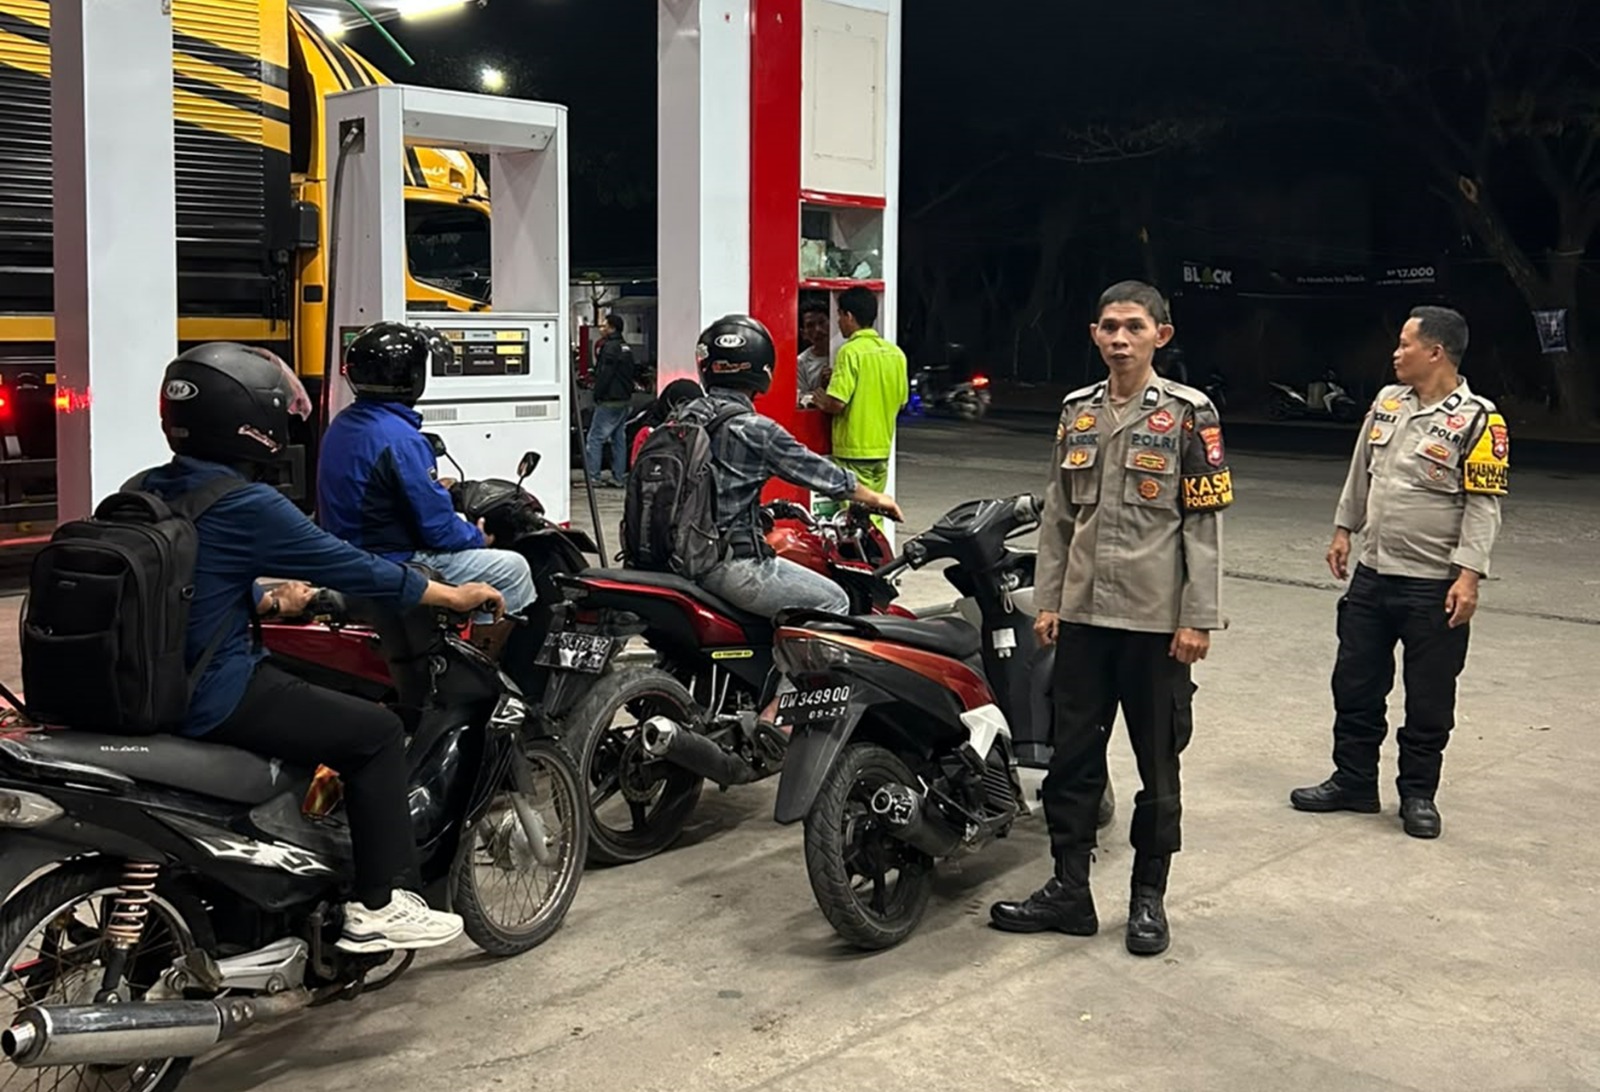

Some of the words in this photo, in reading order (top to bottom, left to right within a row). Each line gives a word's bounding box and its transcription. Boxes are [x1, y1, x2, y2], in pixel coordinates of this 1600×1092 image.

[1131, 433, 1177, 449] POLRI
[1430, 425, 1464, 447] POLRI
[1186, 494, 1220, 508] POLSEK
[779, 693, 799, 709] DW
[798, 688, 832, 707] 3499
[100, 745, 150, 753] BLACK
